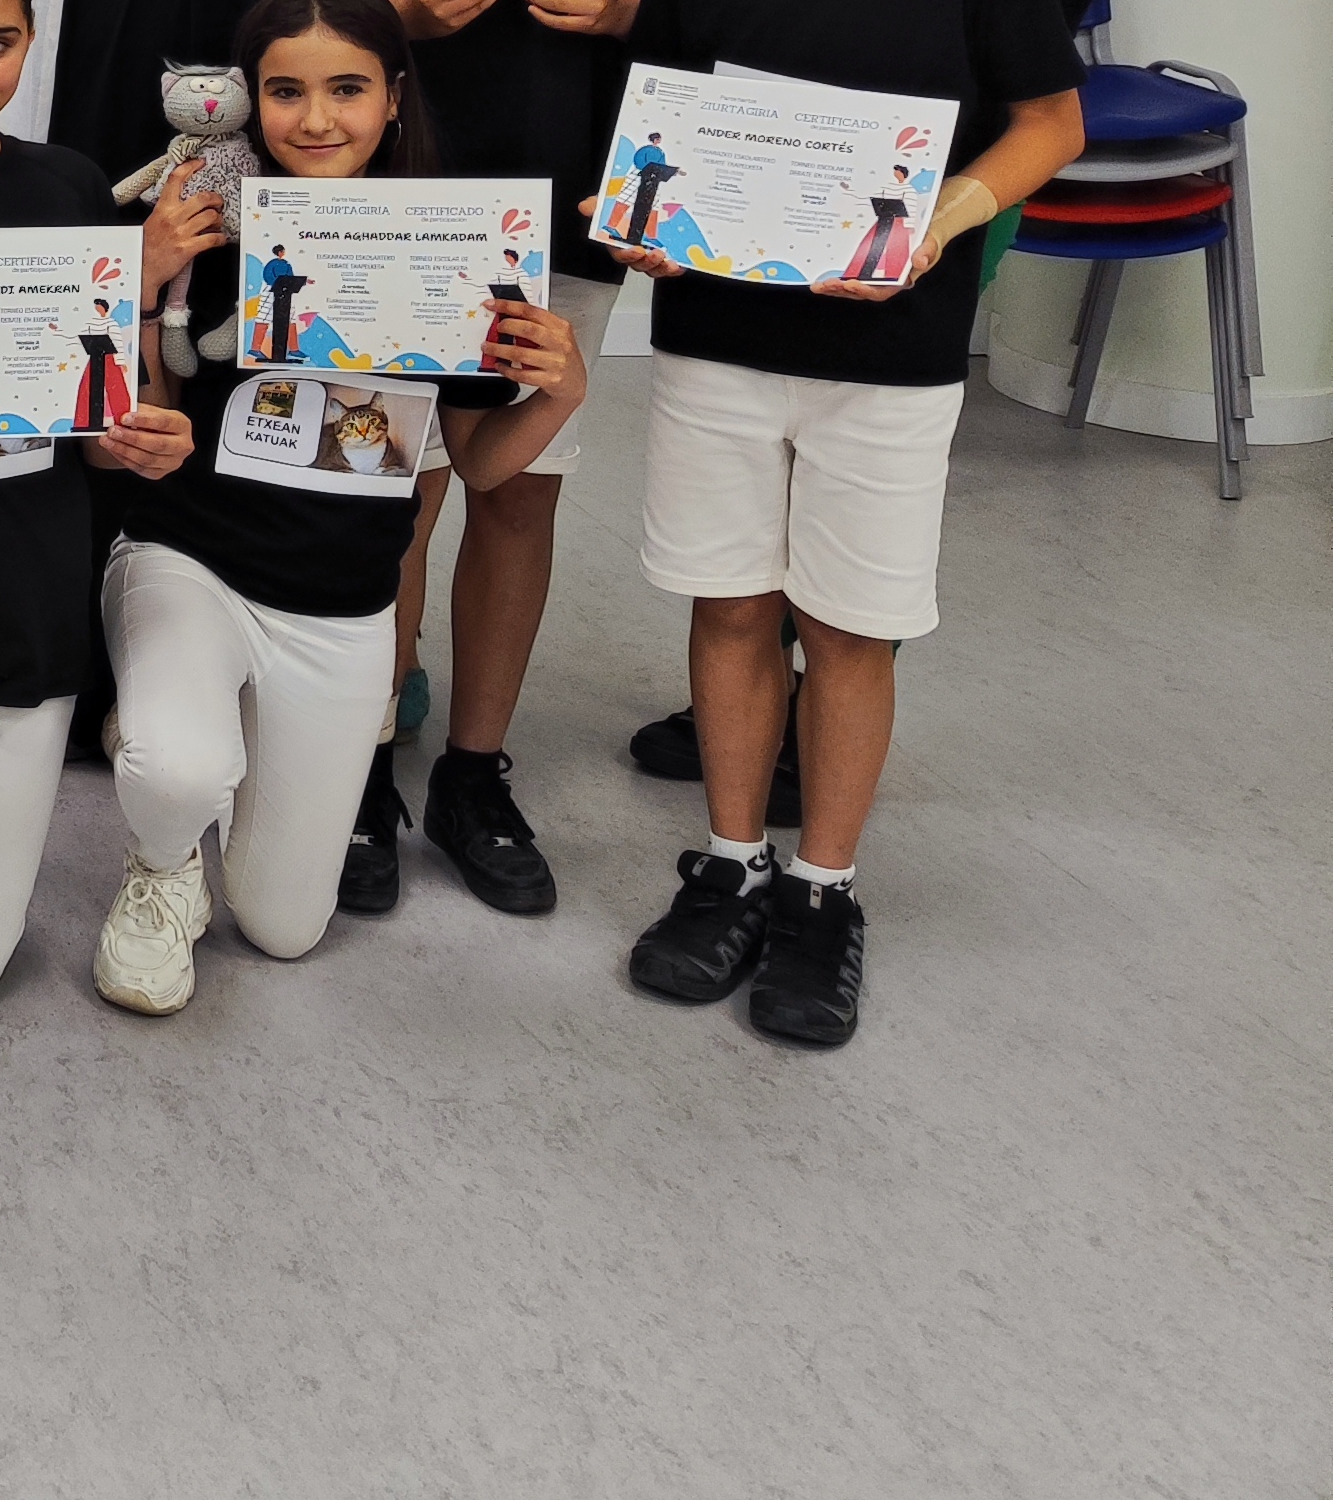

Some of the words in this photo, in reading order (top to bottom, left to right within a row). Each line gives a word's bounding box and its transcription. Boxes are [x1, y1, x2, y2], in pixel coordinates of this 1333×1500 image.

[700, 101, 779, 119] ZIURTAGIRIA
[794, 112, 879, 129] CERTIFICADO
[697, 126, 741, 140] ANDER
[744, 133, 801, 146] MORENO
[805, 141, 853, 153] CORTÉS
[314, 205, 390, 215] ZIURTAGIRIA
[405, 206, 484, 216] CERTIFICADO
[298, 230, 340, 240] SALMA
[415, 232, 487, 242] LAMKADAM
[246, 415, 300, 434] ETXEAN
[245, 430, 298, 449] KATUAK
